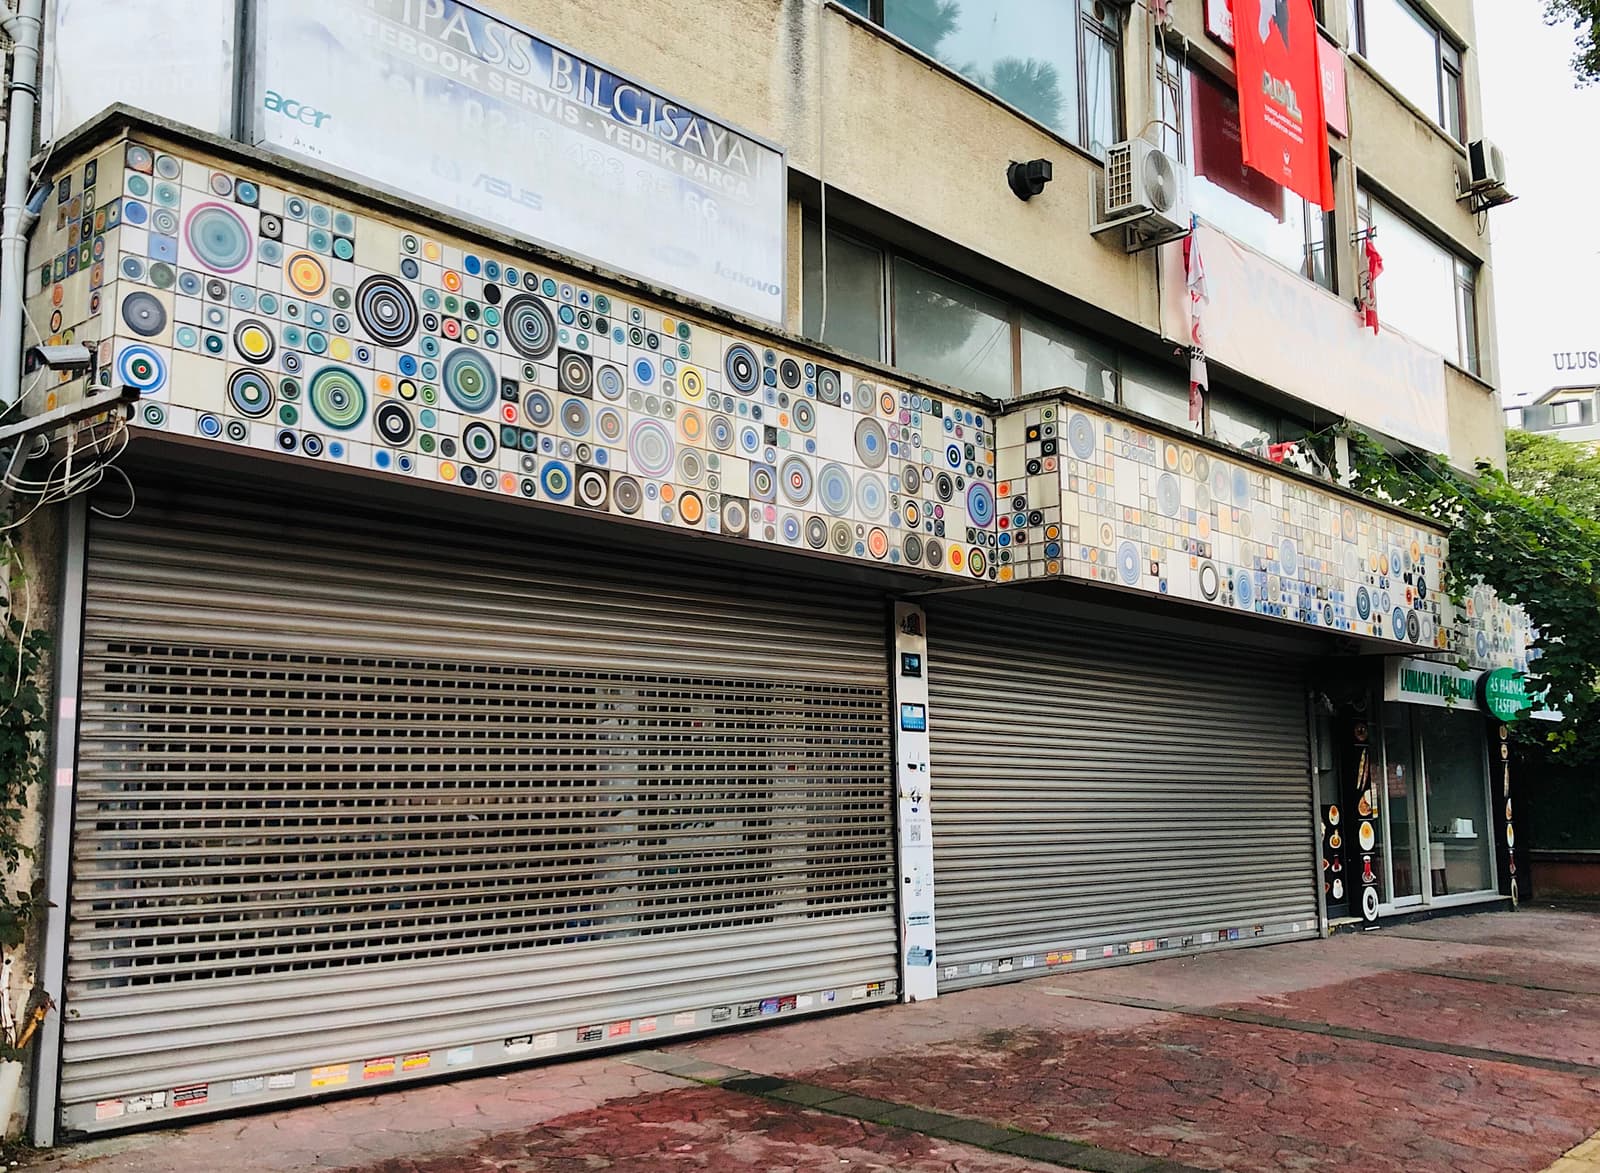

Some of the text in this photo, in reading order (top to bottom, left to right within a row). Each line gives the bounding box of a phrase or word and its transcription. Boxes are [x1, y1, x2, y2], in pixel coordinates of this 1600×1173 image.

[264, 90, 331, 128] acer
[361, 14, 479, 85] TEBOOK
[602, 120, 677, 169] YEDEK
[551, 49, 761, 177] BILGISAYA
[713, 260, 780, 295] lenovo
[1553, 351, 1600, 370] ULUS
